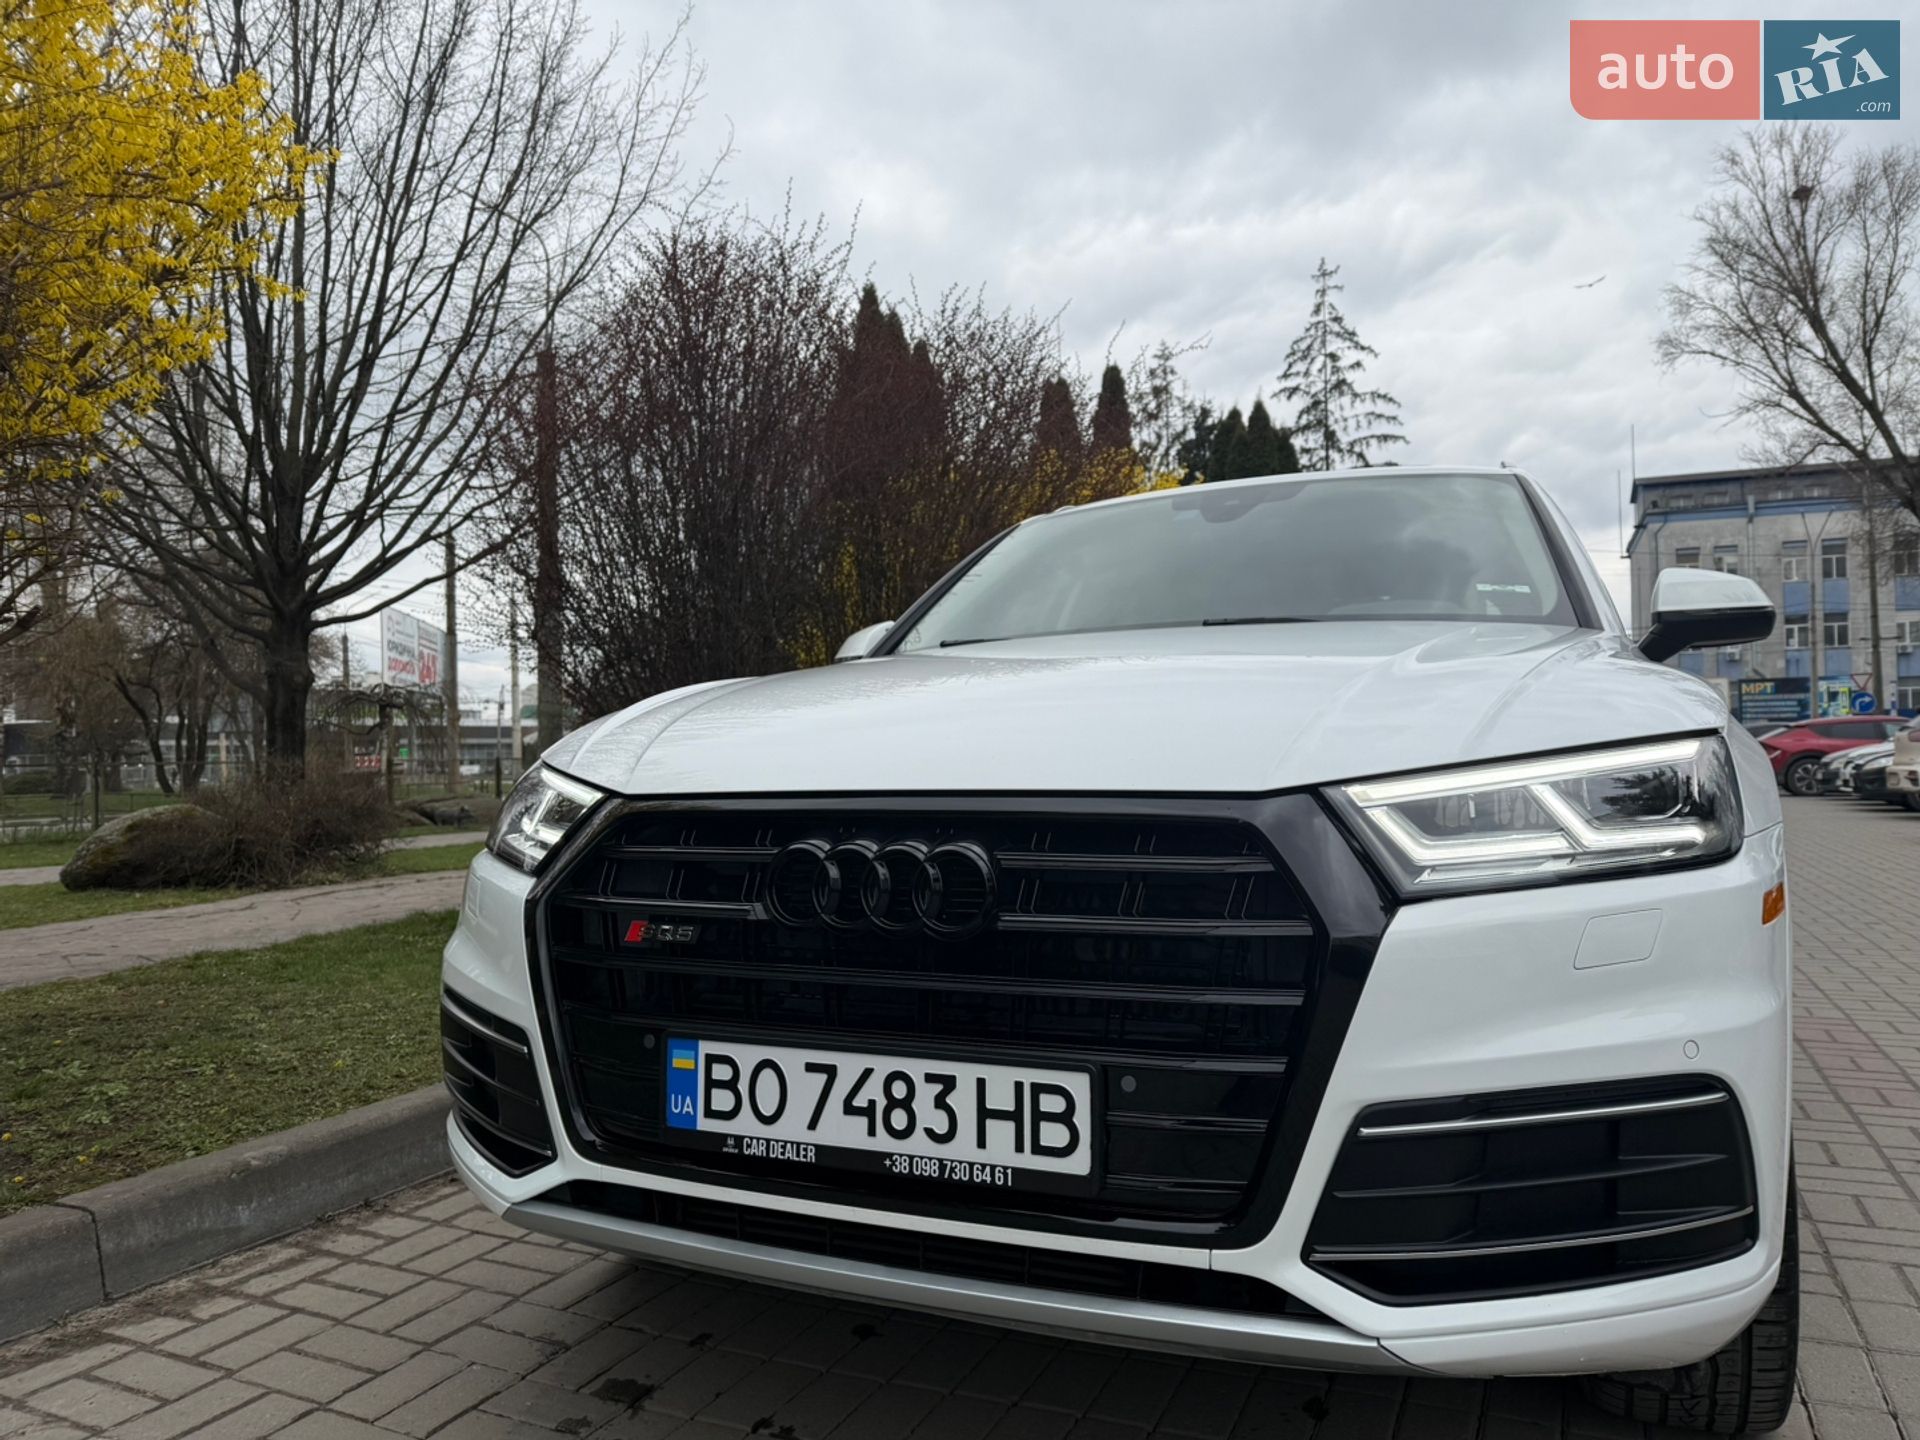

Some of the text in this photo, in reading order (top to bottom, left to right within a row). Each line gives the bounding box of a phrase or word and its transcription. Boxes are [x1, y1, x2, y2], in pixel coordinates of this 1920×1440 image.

[671, 1053, 1081, 1159] UA BO 7483 HB
[743, 1137, 767, 1157] CAR
[769, 1140, 816, 1163] DEALER
[884, 1155, 1013, 1186] +38 098 730 64 61
